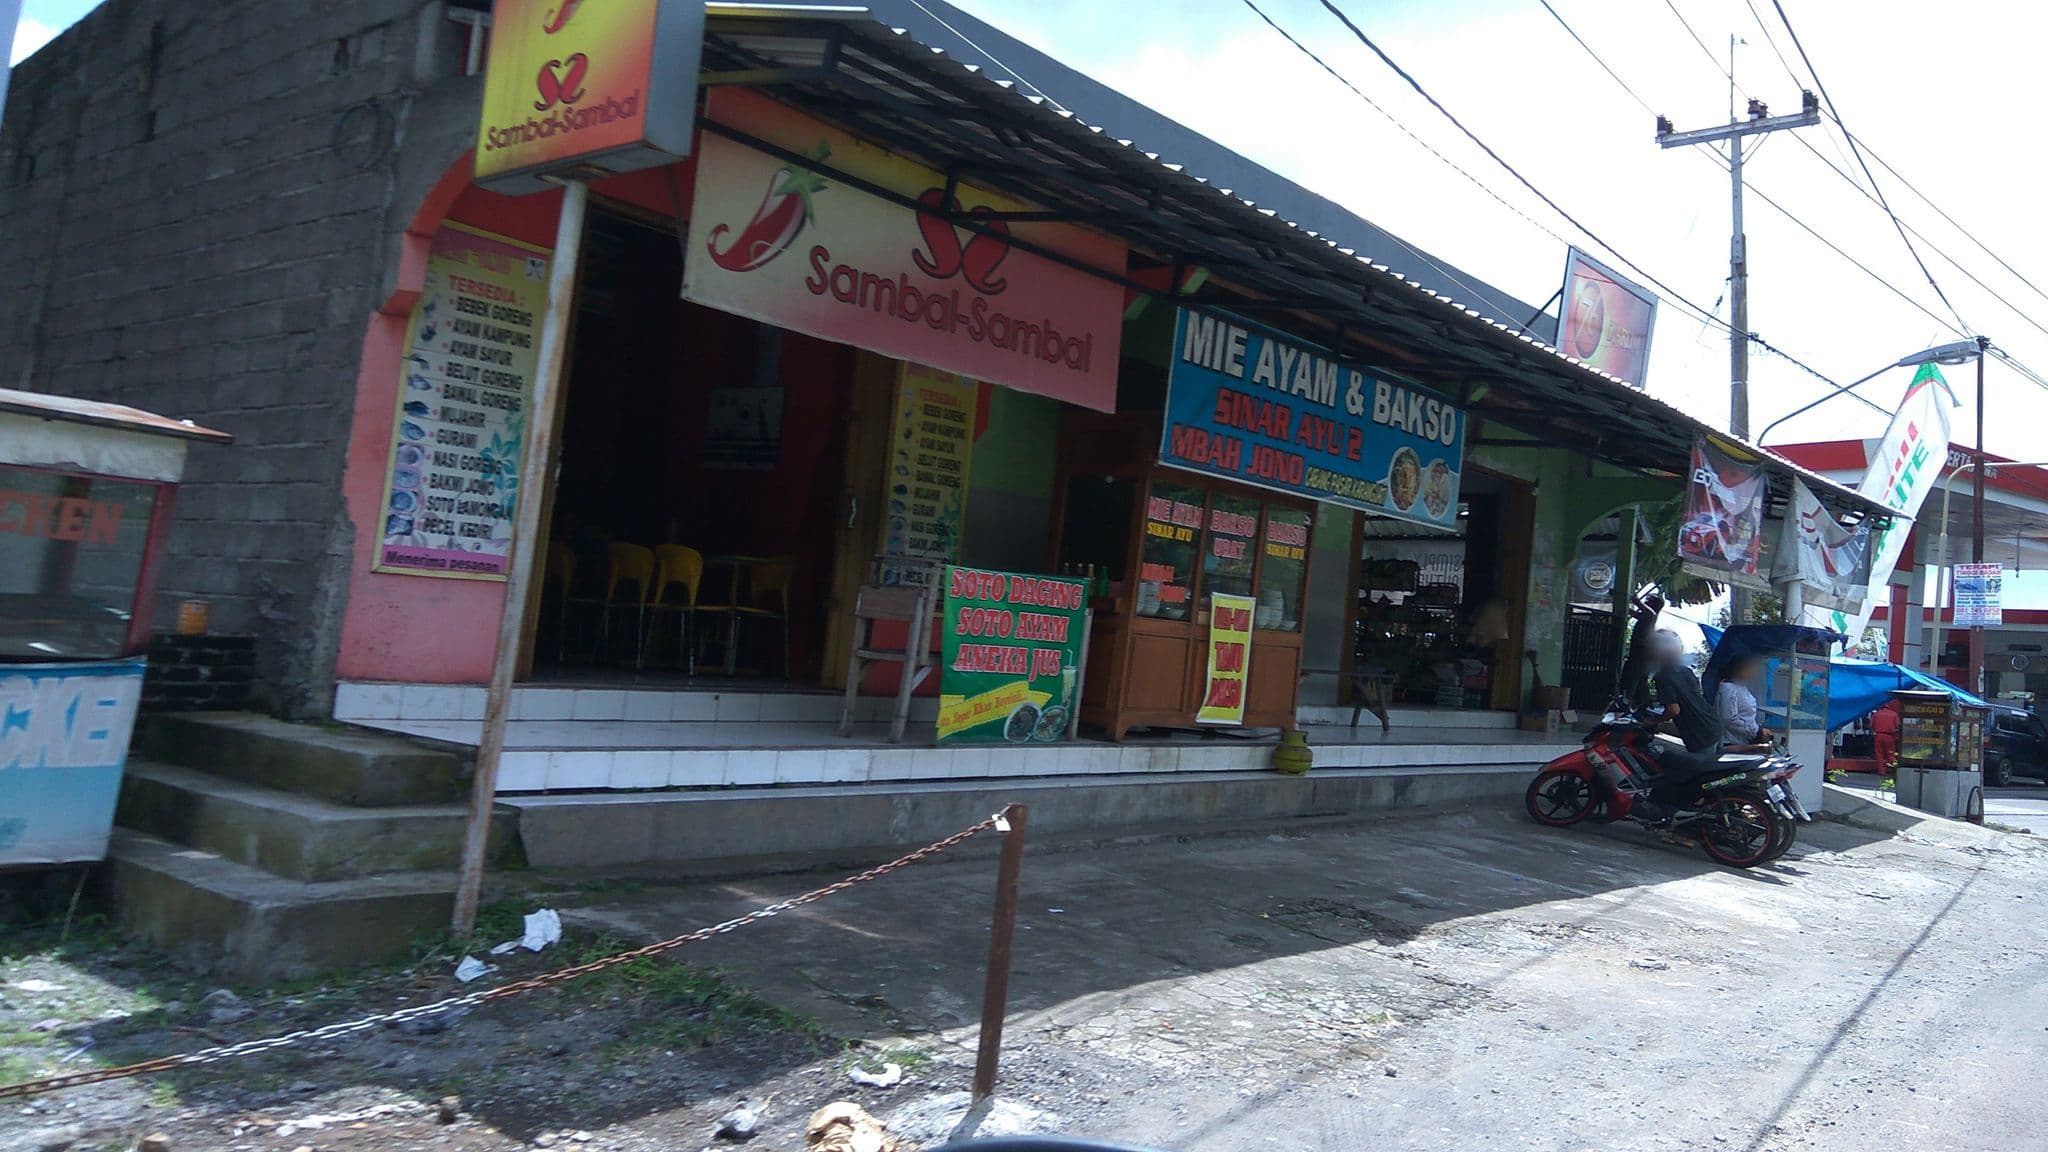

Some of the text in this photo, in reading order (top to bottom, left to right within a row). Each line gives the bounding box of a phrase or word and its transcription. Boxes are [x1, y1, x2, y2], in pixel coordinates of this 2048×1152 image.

[485, 88, 641, 151] Sambal-Sambal
[456, 296, 533, 327] BEBEK GORENG
[806, 245, 1093, 373] Sambal-Sambal
[453, 319, 532, 349] AYAM KAMPUNG
[450, 341, 513, 366] AYAM SAYUR
[446, 361, 523, 390] BELUT GORENG
[1183, 311, 1457, 447] MIE AYAM & BAKSO
[443, 384, 521, 412] BAWAL GORENG
[1213, 387, 1363, 461] SINAR AYU 2
[432, 451, 503, 475] NASI GORENG
[1170, 423, 1305, 486] MBAH JONO
[426, 495, 455, 513] SOTO
[1147, 496, 1172, 523] MIE
[423, 517, 455, 536] PECEL
[1209, 509, 1256, 538] BAKSO
[1266, 520, 1307, 547] BAKSO
[385, 551, 447, 568] Menerima
[951, 569, 1084, 611] SOTO DAGING
[956, 606, 1070, 643] SOTO AYAM
[952, 643, 1063, 683] ANEKA JUS
